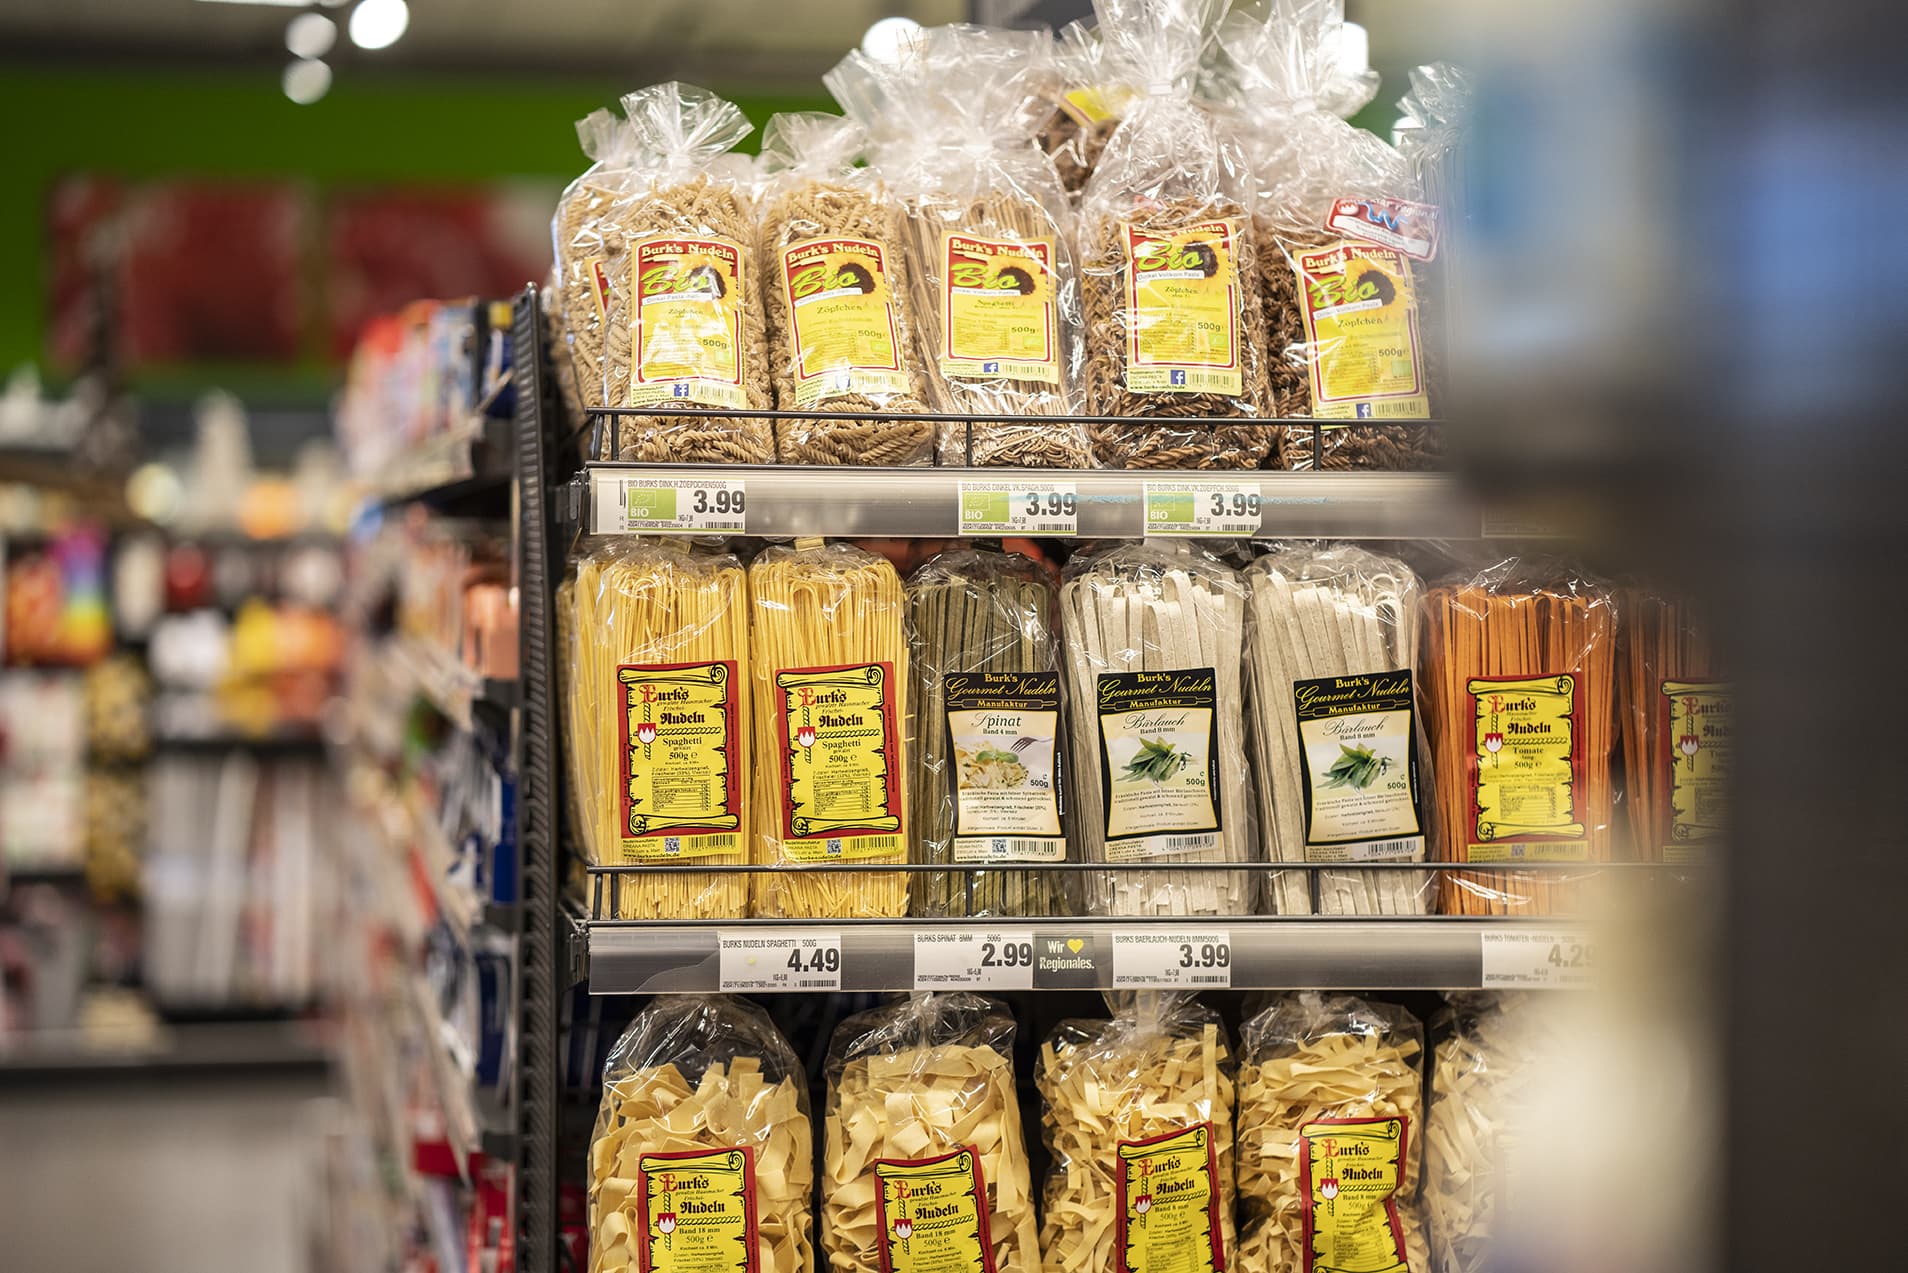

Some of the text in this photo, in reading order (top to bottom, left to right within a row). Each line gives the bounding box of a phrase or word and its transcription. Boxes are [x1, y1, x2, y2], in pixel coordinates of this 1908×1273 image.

[642, 244, 734, 260] Burk's Nudeln
[788, 244, 878, 263] Burk's Nudeln
[952, 239, 993, 255] Burk's
[1352, 248, 1396, 260] Nudeln
[1133, 240, 1204, 271] Bio
[641, 264, 712, 295] Bio
[792, 266, 860, 298] Bio
[952, 262, 1020, 289] Bio
[1309, 275, 1379, 309] Bio
[1198, 322, 1221, 332] 500g
[858, 330, 882, 339] 500g
[702, 339, 727, 350] 500g
[1379, 348, 1403, 357] 500g
[628, 480, 658, 489] BIO BURKS
[693, 490, 745, 514] 3.99
[1026, 492, 1077, 516] 3.99
[1211, 493, 1261, 517] 3.99
[630, 508, 649, 518] BIO
[964, 510, 983, 520] BIO
[1150, 511, 1168, 520] BIO
[985, 674, 1018, 683] Burk's
[1137, 673, 1172, 683] Burk's
[1336, 676, 1370, 688] Burk's
[639, 684, 689, 703] Burk's
[946, 678, 1057, 700] Gourmet Nudeln
[1098, 676, 1212, 704] Gourmet Nudeln
[1296, 678, 1409, 711] Gourmet Nudeln
[798, 688, 847, 708] Burk's
[977, 699, 1028, 708] Manufaktur
[1130, 699, 1182, 709] Manufaktur
[1328, 703, 1381, 715] Manufaktur
[660, 711, 706, 725] Nudeln
[819, 714, 863, 728] Nudeln
[971, 712, 1022, 729] Spinat
[1123, 712, 1190, 730] Bärlauch
[1507, 722, 1552, 735] Nudeln
[662, 737, 702, 747] Spaghetti
[822, 739, 861, 750] Spaghetti
[669, 752, 689, 760] 500g
[829, 755, 848, 763] 500g
[1030, 779, 1049, 788] 500g
[1186, 778, 1206, 787] 500g
[1387, 782, 1407, 790] 500g
[722, 939, 817, 949] BURKS NUDELN SPAGHETTI 500G
[918, 934, 1002, 943] BURKS SPINAT 500G
[1115, 936, 1134, 944] BURKS
[1048, 940, 1065, 954] Wir
[787, 948, 840, 972] 4.49
[981, 943, 1033, 967] 2.99
[1179, 944, 1230, 968] 3.99
[1040, 957, 1095, 973] Regionales.
[1321, 1138, 1370, 1159] Burk's
[1138, 1156, 1182, 1177] Burk's
[1342, 1167, 1383, 1180] Nudeln
[659, 1173, 710, 1194] Burk's
[894, 1180, 942, 1200] Burk's
[1156, 1178, 1195, 1195] Nudeln
[680, 1200, 725, 1214] Nudeln
[915, 1204, 959, 1220] Nudeln
[1155, 1205, 1171, 1213] Band
[686, 1236, 705, 1244] 500g
[923, 1239, 942, 1248] 500g
